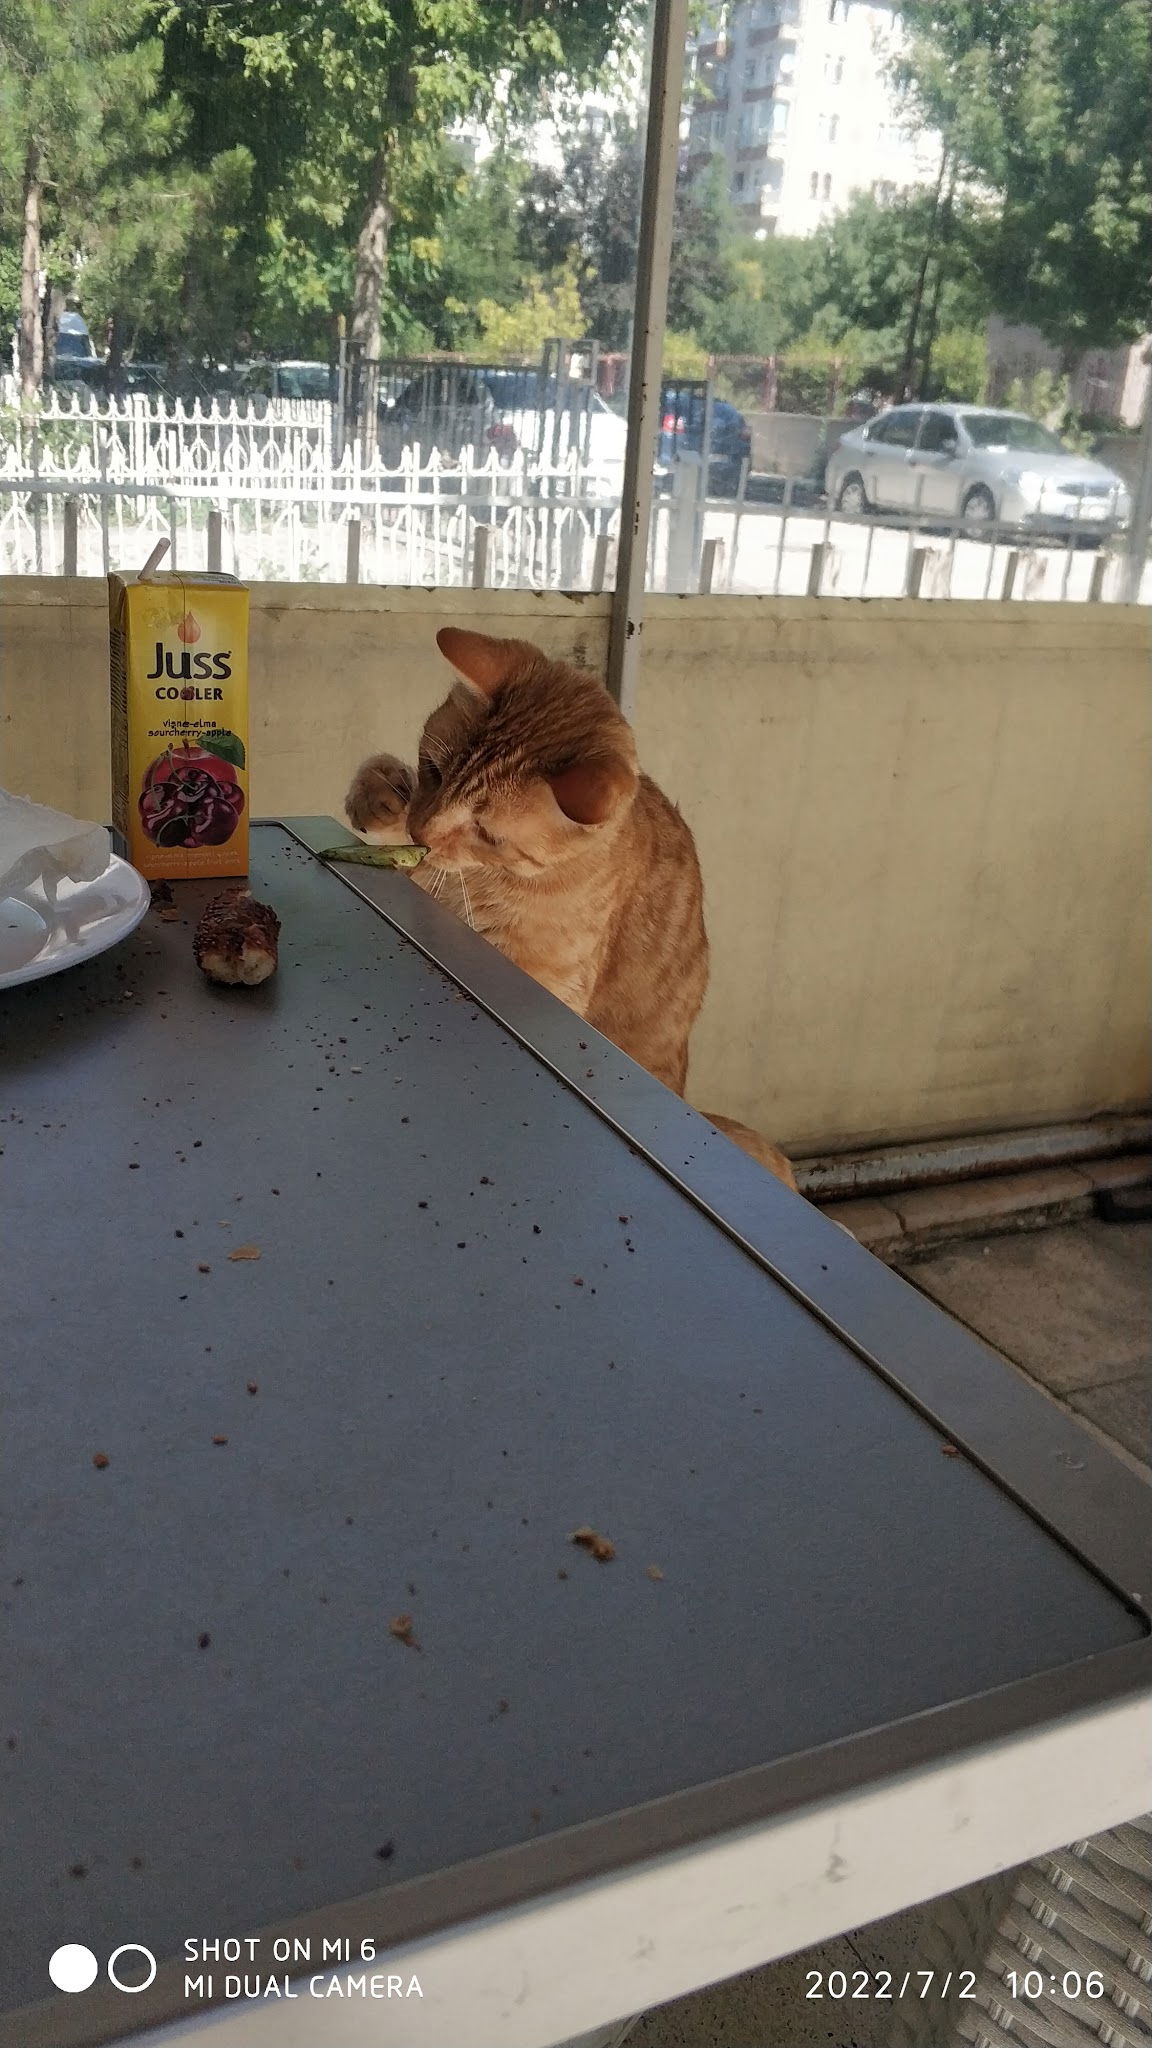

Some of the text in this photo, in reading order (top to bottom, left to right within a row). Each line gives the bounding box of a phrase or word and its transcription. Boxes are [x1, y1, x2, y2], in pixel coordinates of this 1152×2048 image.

[147, 642, 232, 680] Juss
[155, 686, 224, 701] COOLER
[147, 727, 232, 738] sourcherry-apple
